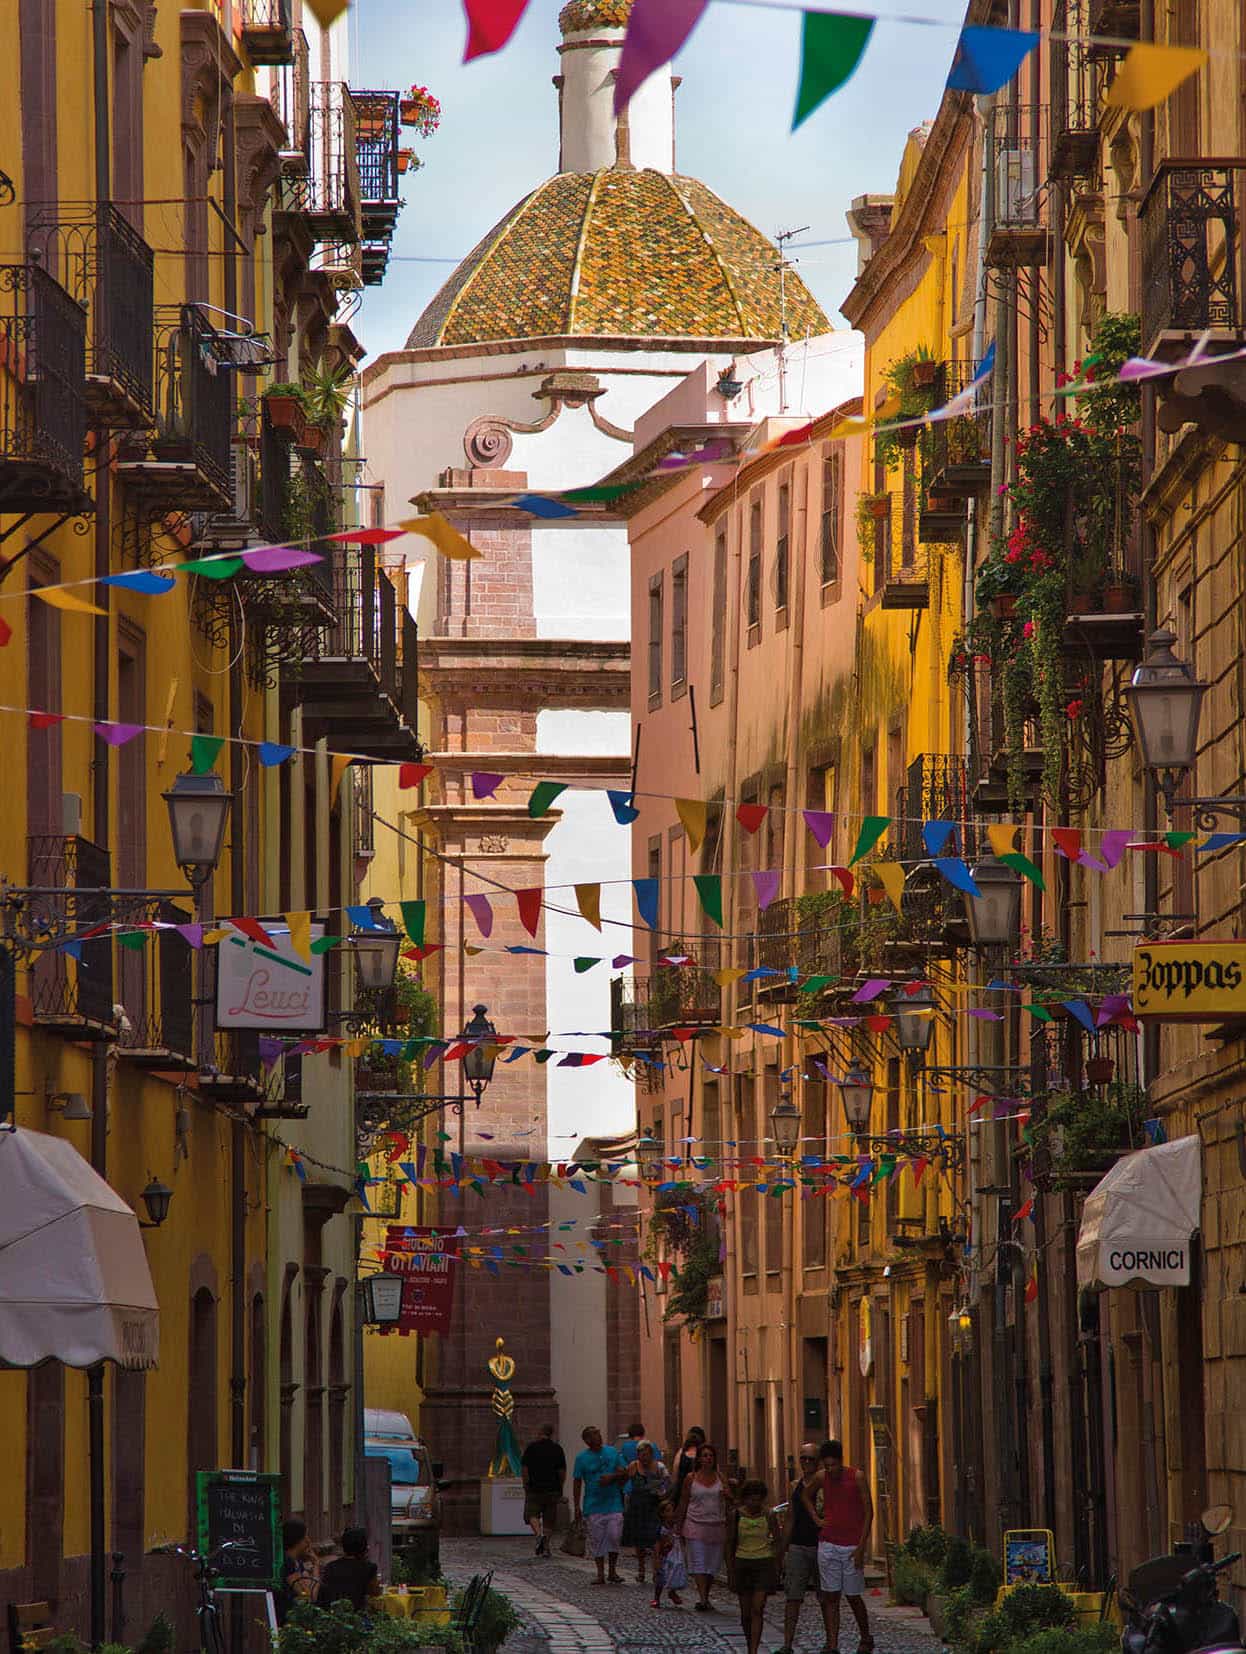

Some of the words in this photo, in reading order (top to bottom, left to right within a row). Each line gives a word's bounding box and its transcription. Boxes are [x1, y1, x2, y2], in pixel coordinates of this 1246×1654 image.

[228, 969, 311, 1019] Leuci
[1137, 952, 1242, 1007] Zoppas
[1110, 1250, 1184, 1270] CORNICI
